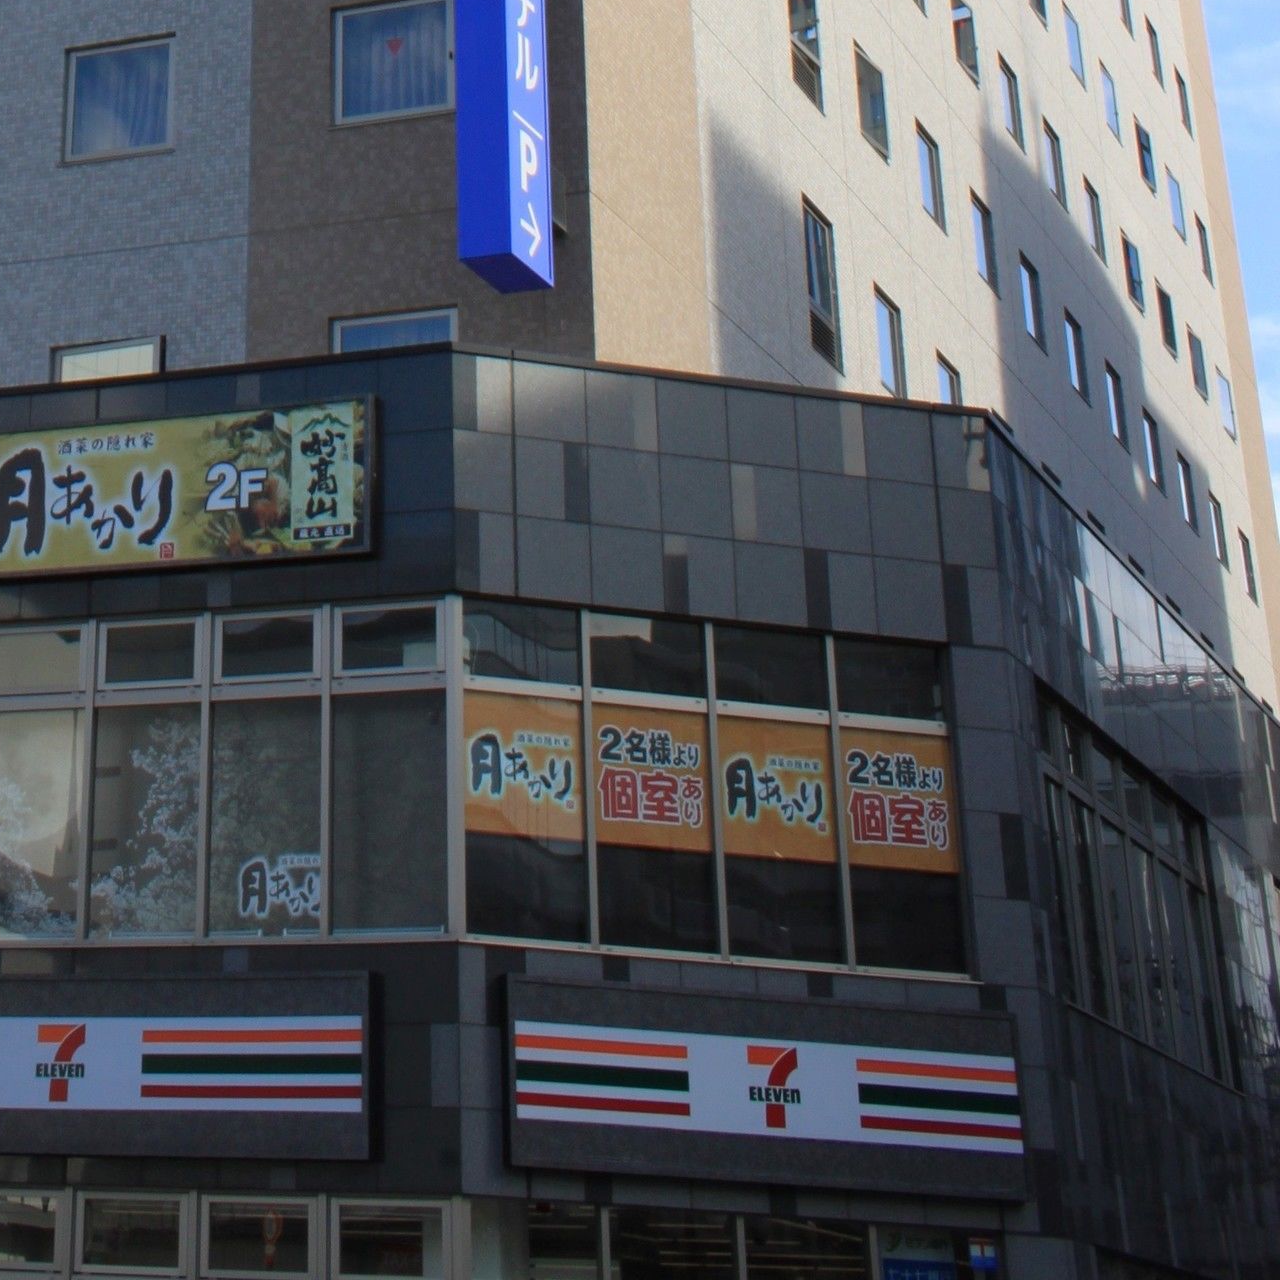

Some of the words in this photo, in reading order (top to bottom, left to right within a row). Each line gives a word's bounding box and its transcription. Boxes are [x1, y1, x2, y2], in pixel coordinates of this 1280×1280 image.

[520, 129, 538, 192] P
[58, 431, 154, 456] 酒菜の隠れ家
[300, 428, 346, 519] 妙高山
[205, 461, 268, 512] 2F
[471, 733, 572, 801] 月あかり
[599, 724, 701, 769] 2名様より
[847, 749, 944, 792] 2名様より
[598, 766, 703, 828] 個室あり
[726, 757, 823, 823] 月あかり
[848, 788, 949, 850] 個室あり
[37, 1023, 86, 1102] 7
[747, 1044, 798, 1128] 7
